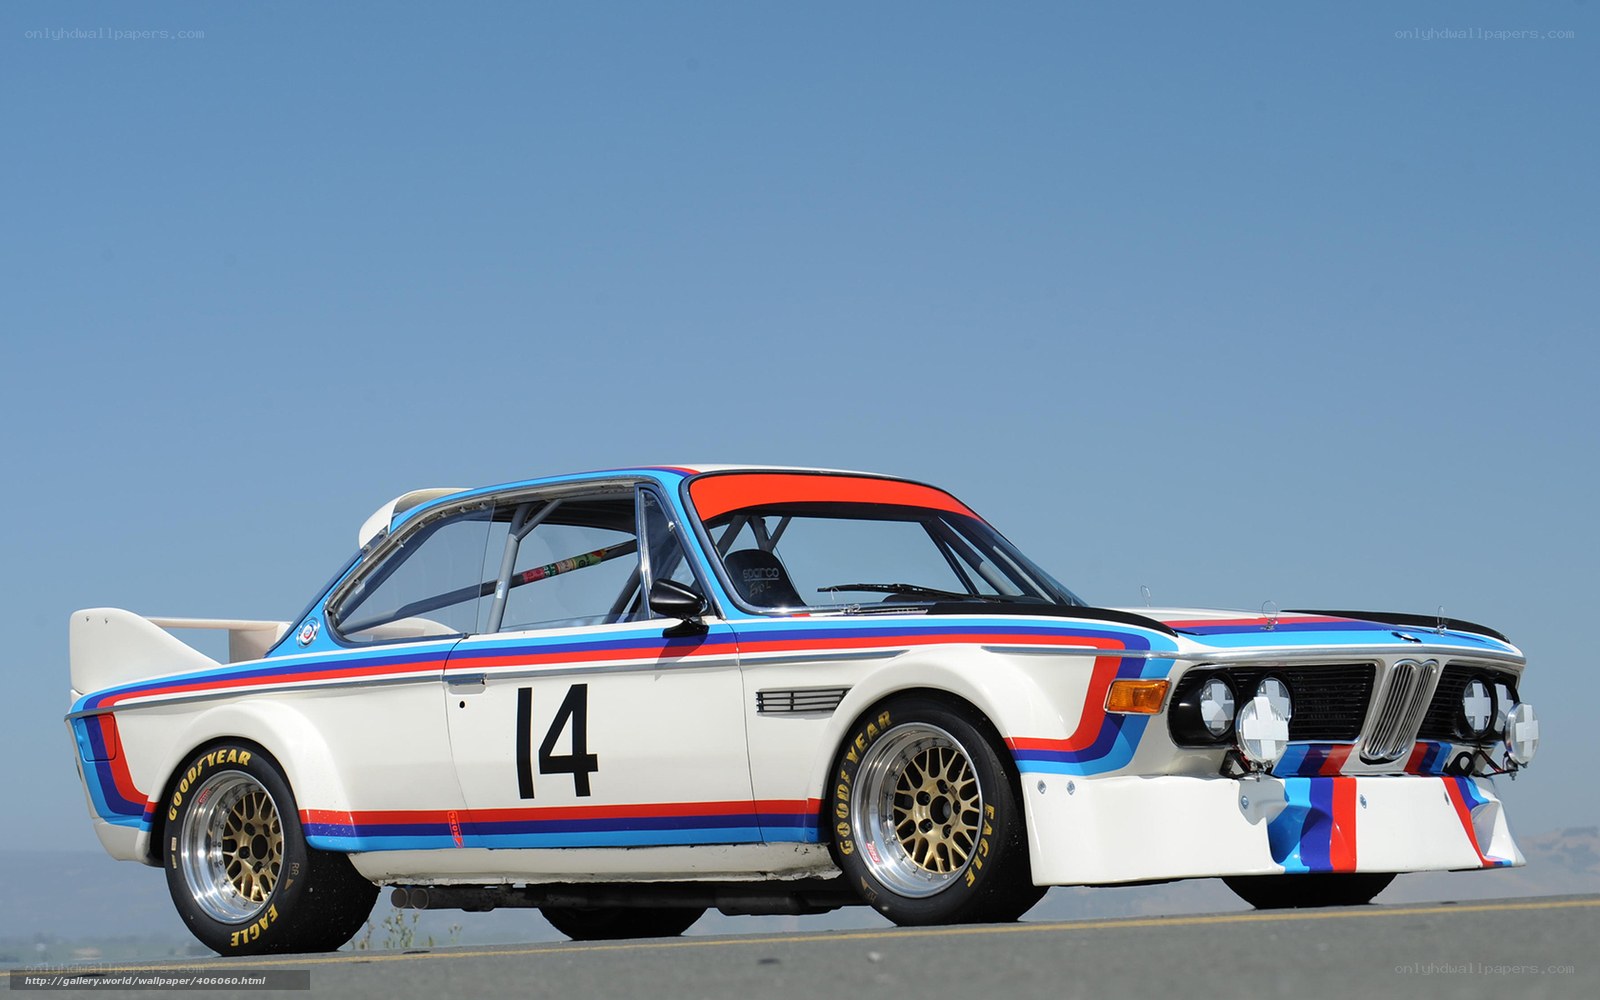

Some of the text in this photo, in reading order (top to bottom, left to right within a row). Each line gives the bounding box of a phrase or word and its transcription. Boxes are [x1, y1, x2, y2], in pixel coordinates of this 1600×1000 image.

[516, 683, 599, 800] 14
[965, 802, 995, 888] EAGLE
[230, 903, 279, 947] EAGLE
